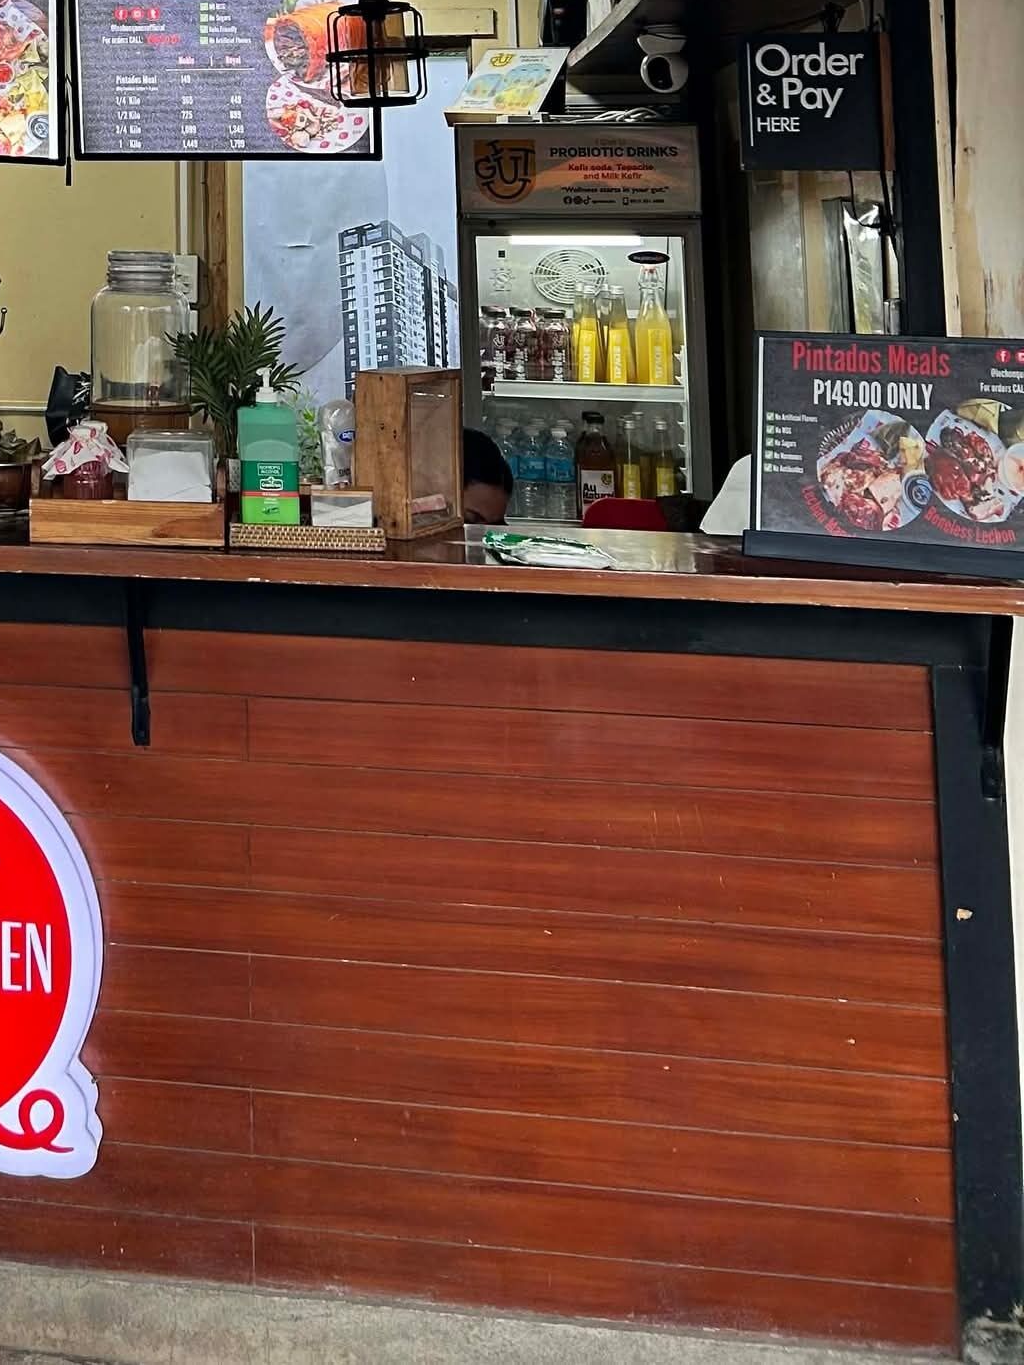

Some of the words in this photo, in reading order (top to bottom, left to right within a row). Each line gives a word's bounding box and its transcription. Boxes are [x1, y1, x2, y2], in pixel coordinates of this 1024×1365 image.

[755, 42, 864, 77] Order
[128, 96, 141, 105] Kilo
[756, 83, 777, 106] &
[782, 77, 844, 118] Pay
[128, 110, 141, 120] Kilo
[129, 125, 142, 134] Kilo
[756, 117, 801, 133] HERE
[129, 139, 142, 149] Kilo
[549, 146, 625, 158] PROBIOTIC
[627, 145, 680, 158] DRINKS
[602, 172, 619, 180] Milk
[621, 172, 642, 180] Kefir
[791, 340, 880, 376] Pintados
[887, 344, 952, 378] Meals
[980, 382, 990, 392] For
[813, 378, 882, 409] P149.00
[887, 383, 933, 411] ONLY
[923, 505, 974, 539] Boneless
[976, 527, 1017, 544] Lechon
